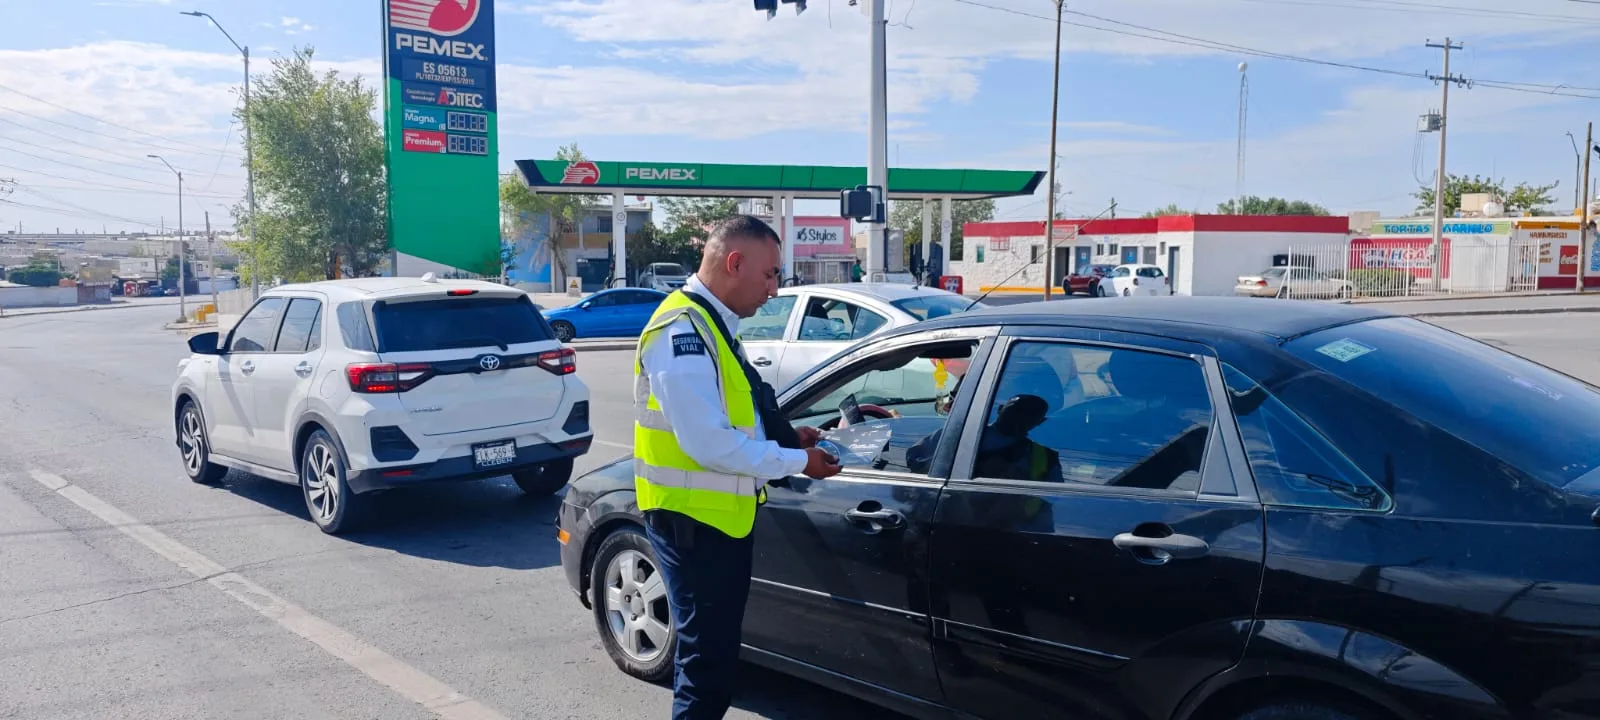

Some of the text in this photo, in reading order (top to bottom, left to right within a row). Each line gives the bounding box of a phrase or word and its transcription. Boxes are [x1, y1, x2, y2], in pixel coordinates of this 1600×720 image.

[396, 33, 485, 60] PEMEX
[423, 62, 467, 78] ES 05613
[626, 167, 696, 181] PEMEX
[808, 228, 837, 245] Stylos
[680, 344, 699, 352] VIAL
